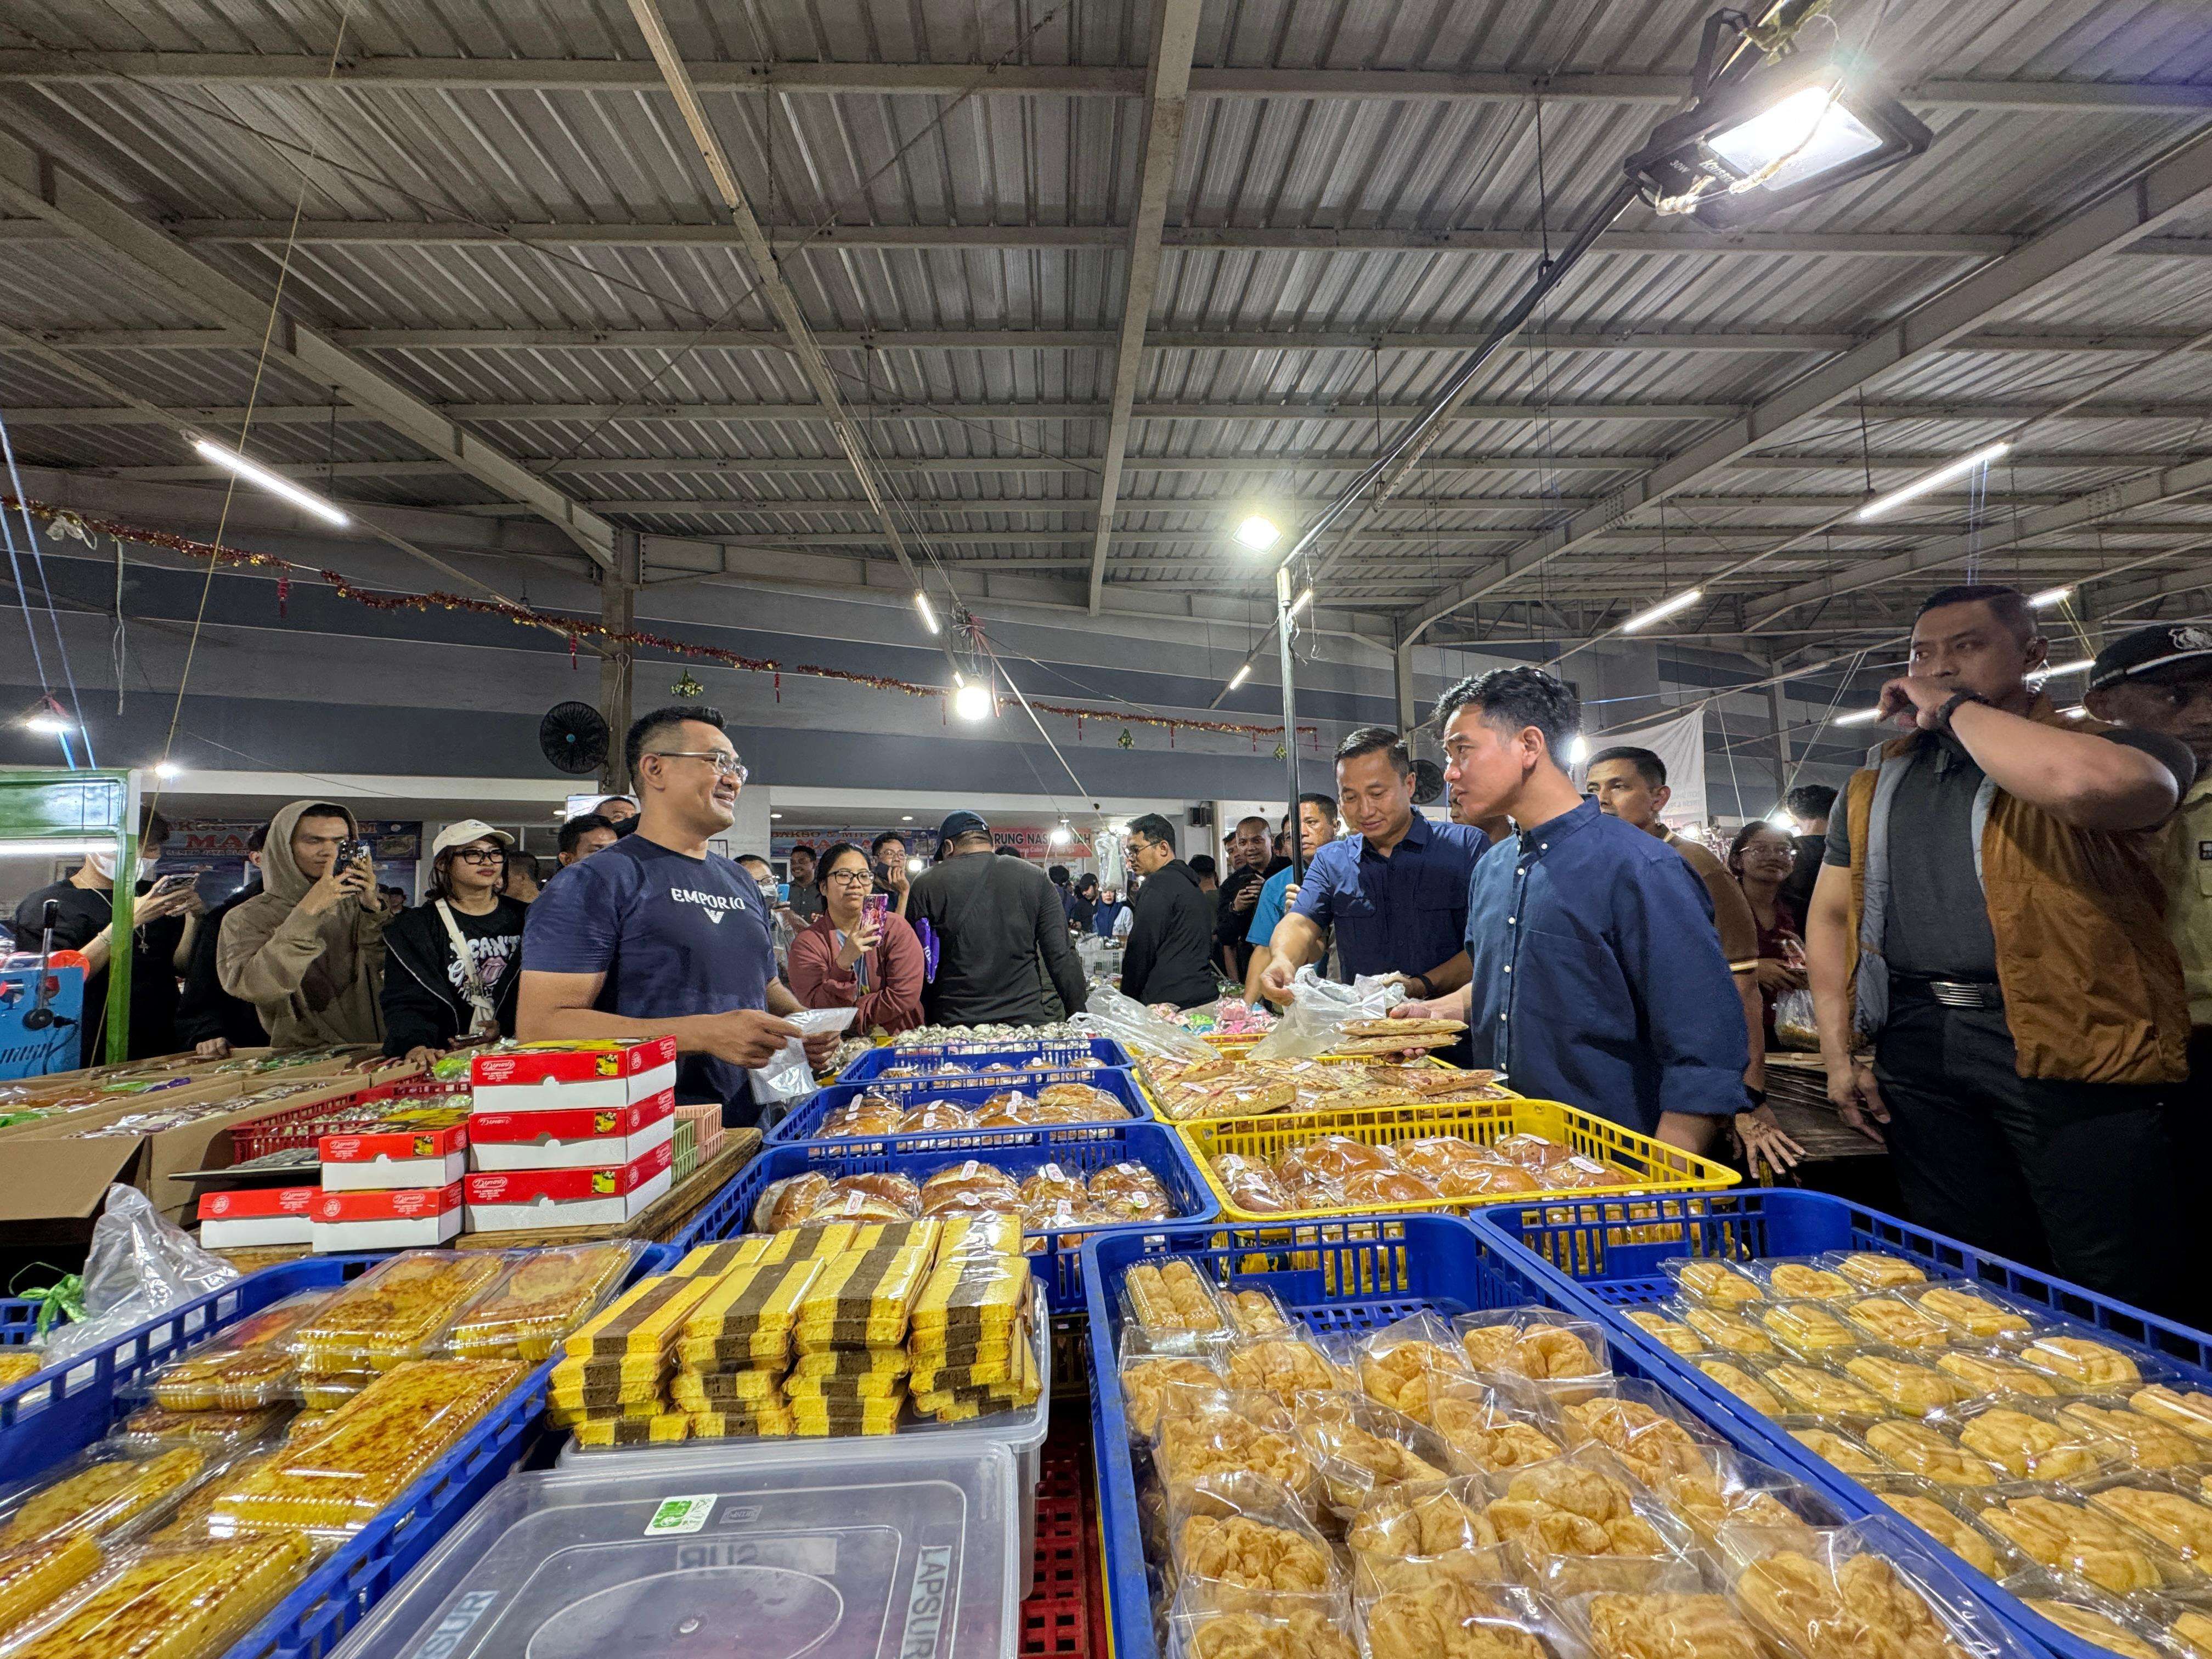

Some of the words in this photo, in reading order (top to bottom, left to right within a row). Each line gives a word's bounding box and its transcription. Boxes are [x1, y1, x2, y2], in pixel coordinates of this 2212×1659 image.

[994, 833, 1024, 844] RUNG
[1027, 833, 1050, 844] NAS
[670, 888, 746, 910] EMPORIO
[467, 935, 521, 960] CAN'T
[482, 1061, 514, 1070] Dynasty
[903, 1547, 949, 1658] LAPSUR
